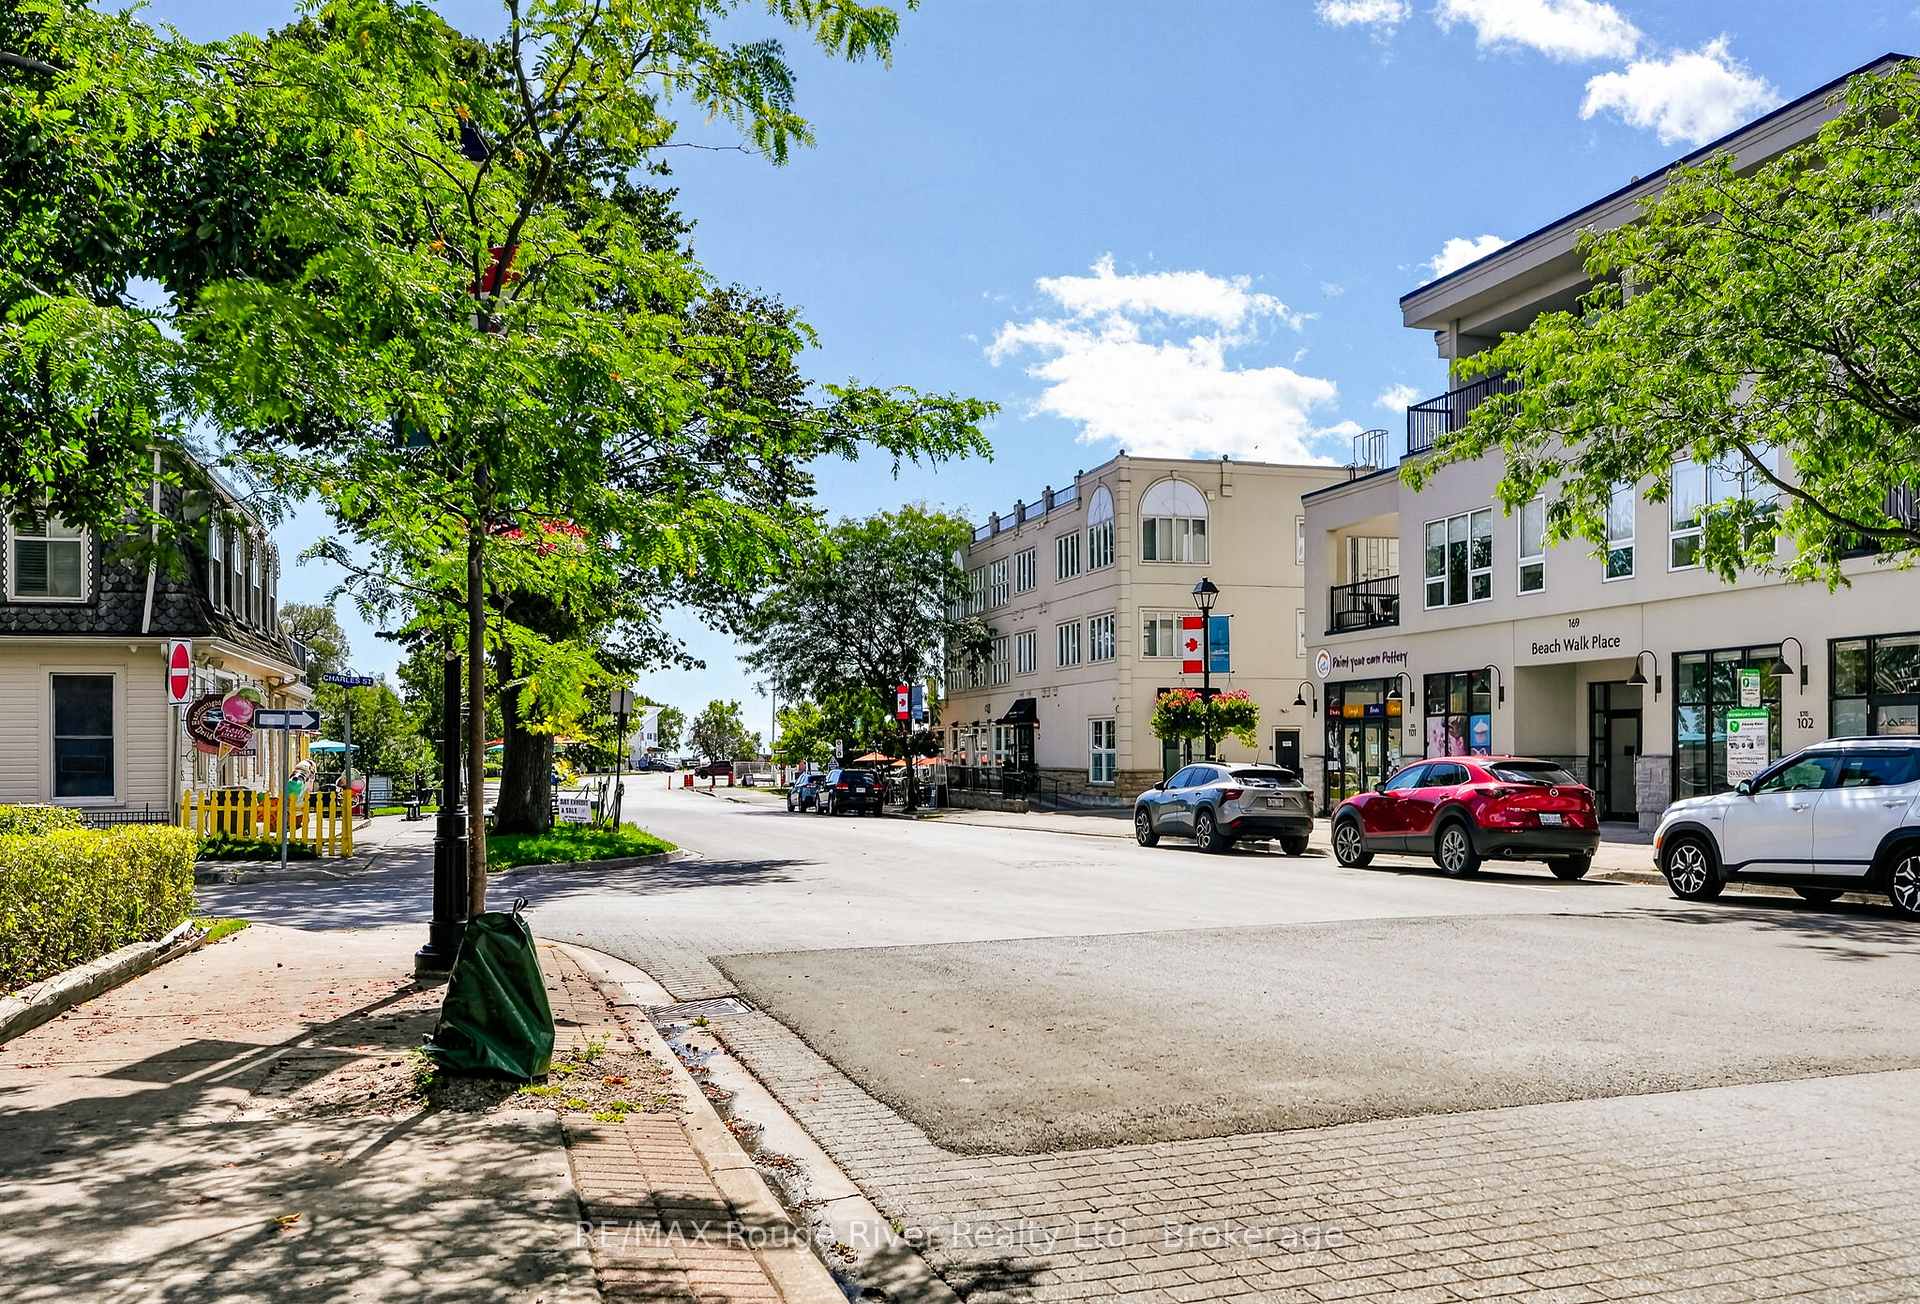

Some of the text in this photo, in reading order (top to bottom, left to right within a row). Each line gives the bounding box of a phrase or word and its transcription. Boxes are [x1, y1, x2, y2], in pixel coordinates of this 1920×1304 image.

[1568, 617, 1580, 628] 169
[1531, 633, 1621, 655] Beach Walk Place
[1382, 651, 1408, 668] Pottery
[322, 674, 361, 684] CHARLES
[1797, 718, 1814, 729] 102
